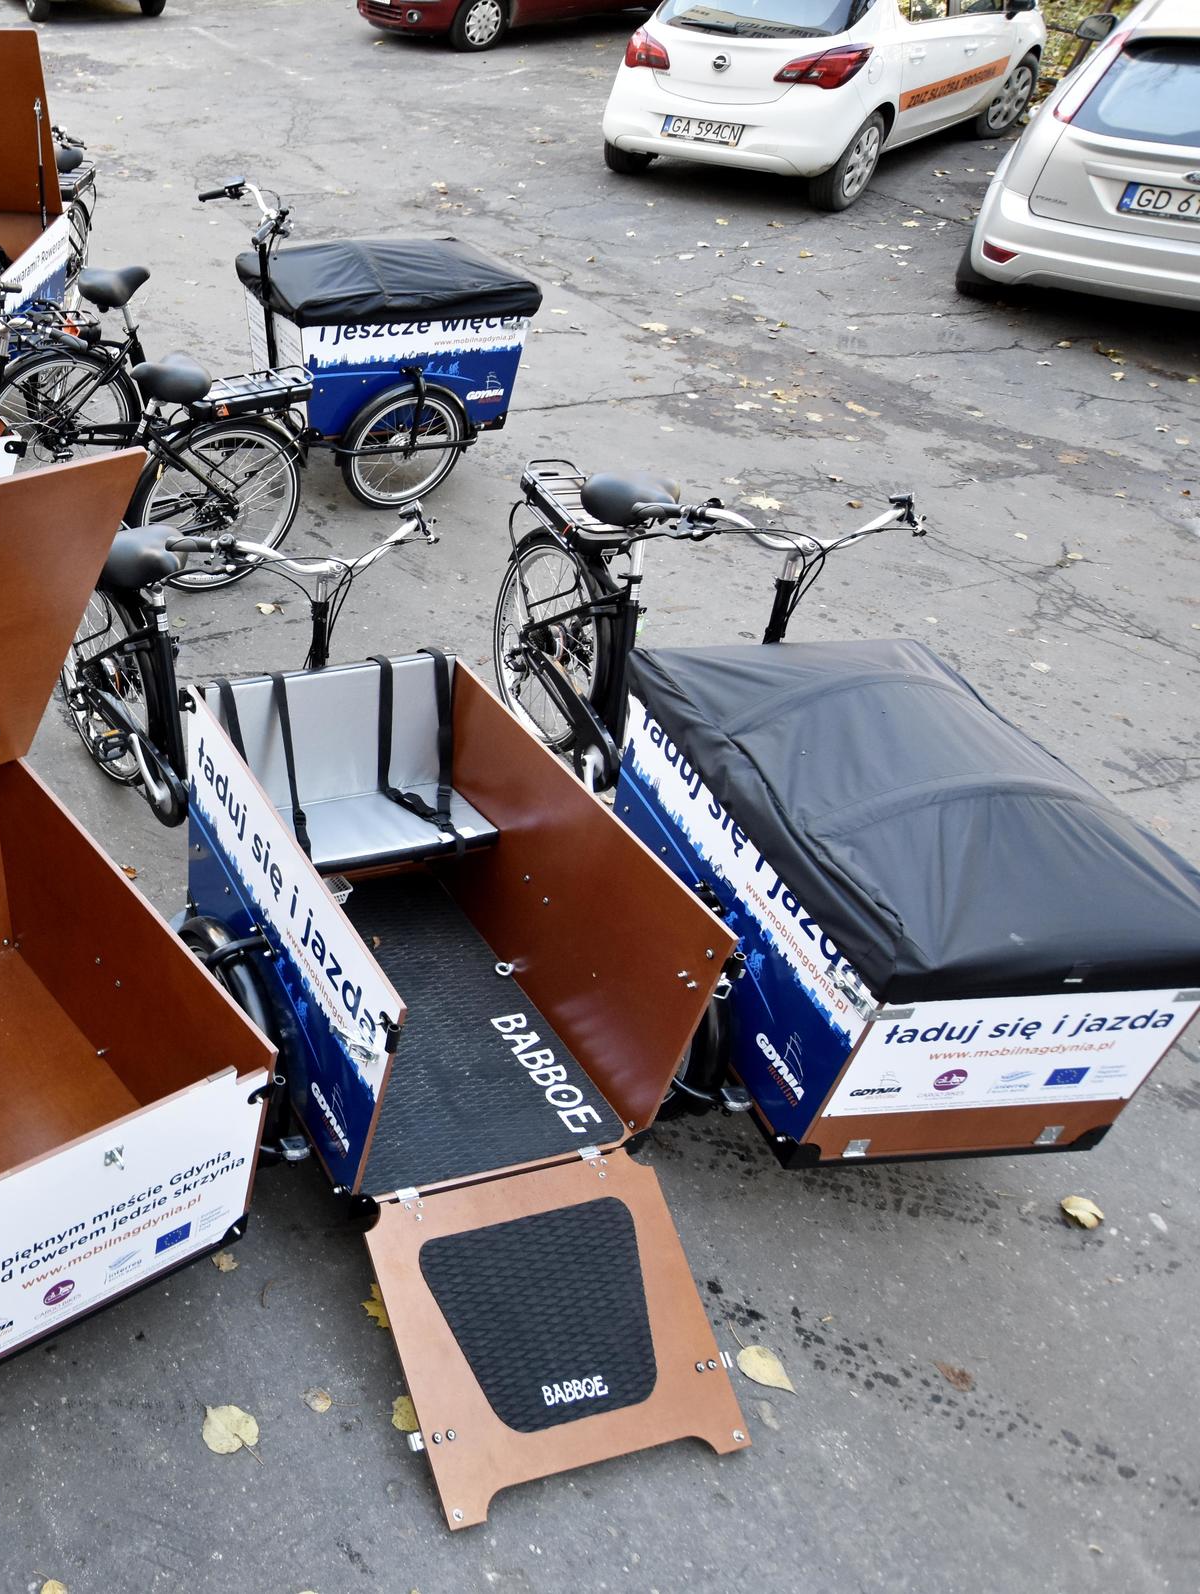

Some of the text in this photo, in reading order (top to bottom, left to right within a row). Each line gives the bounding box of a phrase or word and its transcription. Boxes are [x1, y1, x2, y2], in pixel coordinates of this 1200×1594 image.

[672, 118, 690, 135] GA
[695, 121, 741, 141] 594CN
[1137, 188, 1172, 210] GD
[434, 334, 516, 346] www.mobilnagdynia.pl
[198, 737, 248, 842] ładuj
[251, 832, 284, 903] się
[289, 884, 299, 919] i
[745, 881, 849, 1015] www.mobilnagdynia.pl
[884, 1009, 1175, 1045] ładuj się i jazda
[928, 1041, 1116, 1061] www.mobilnagdynia.pl
[490, 1012, 603, 1133] BABBOE
[756, 1032, 805, 1101] GDYNIA
[849, 1087, 902, 1097] GDYNIA
[311, 1081, 350, 1153] GDYNIA
[1, 1221, 86, 1272] pięknym
[92, 1183, 163, 1222] mieście
[169, 1150, 231, 1187] Gdynia
[20, 1225, 106, 1275] rowerem
[111, 1196, 168, 1233] jedzie
[172, 1156, 246, 1199] skrzynia
[21, 1194, 202, 1291] www.mobilnagdynia.pl
[541, 1375, 609, 1406] BABBOE
